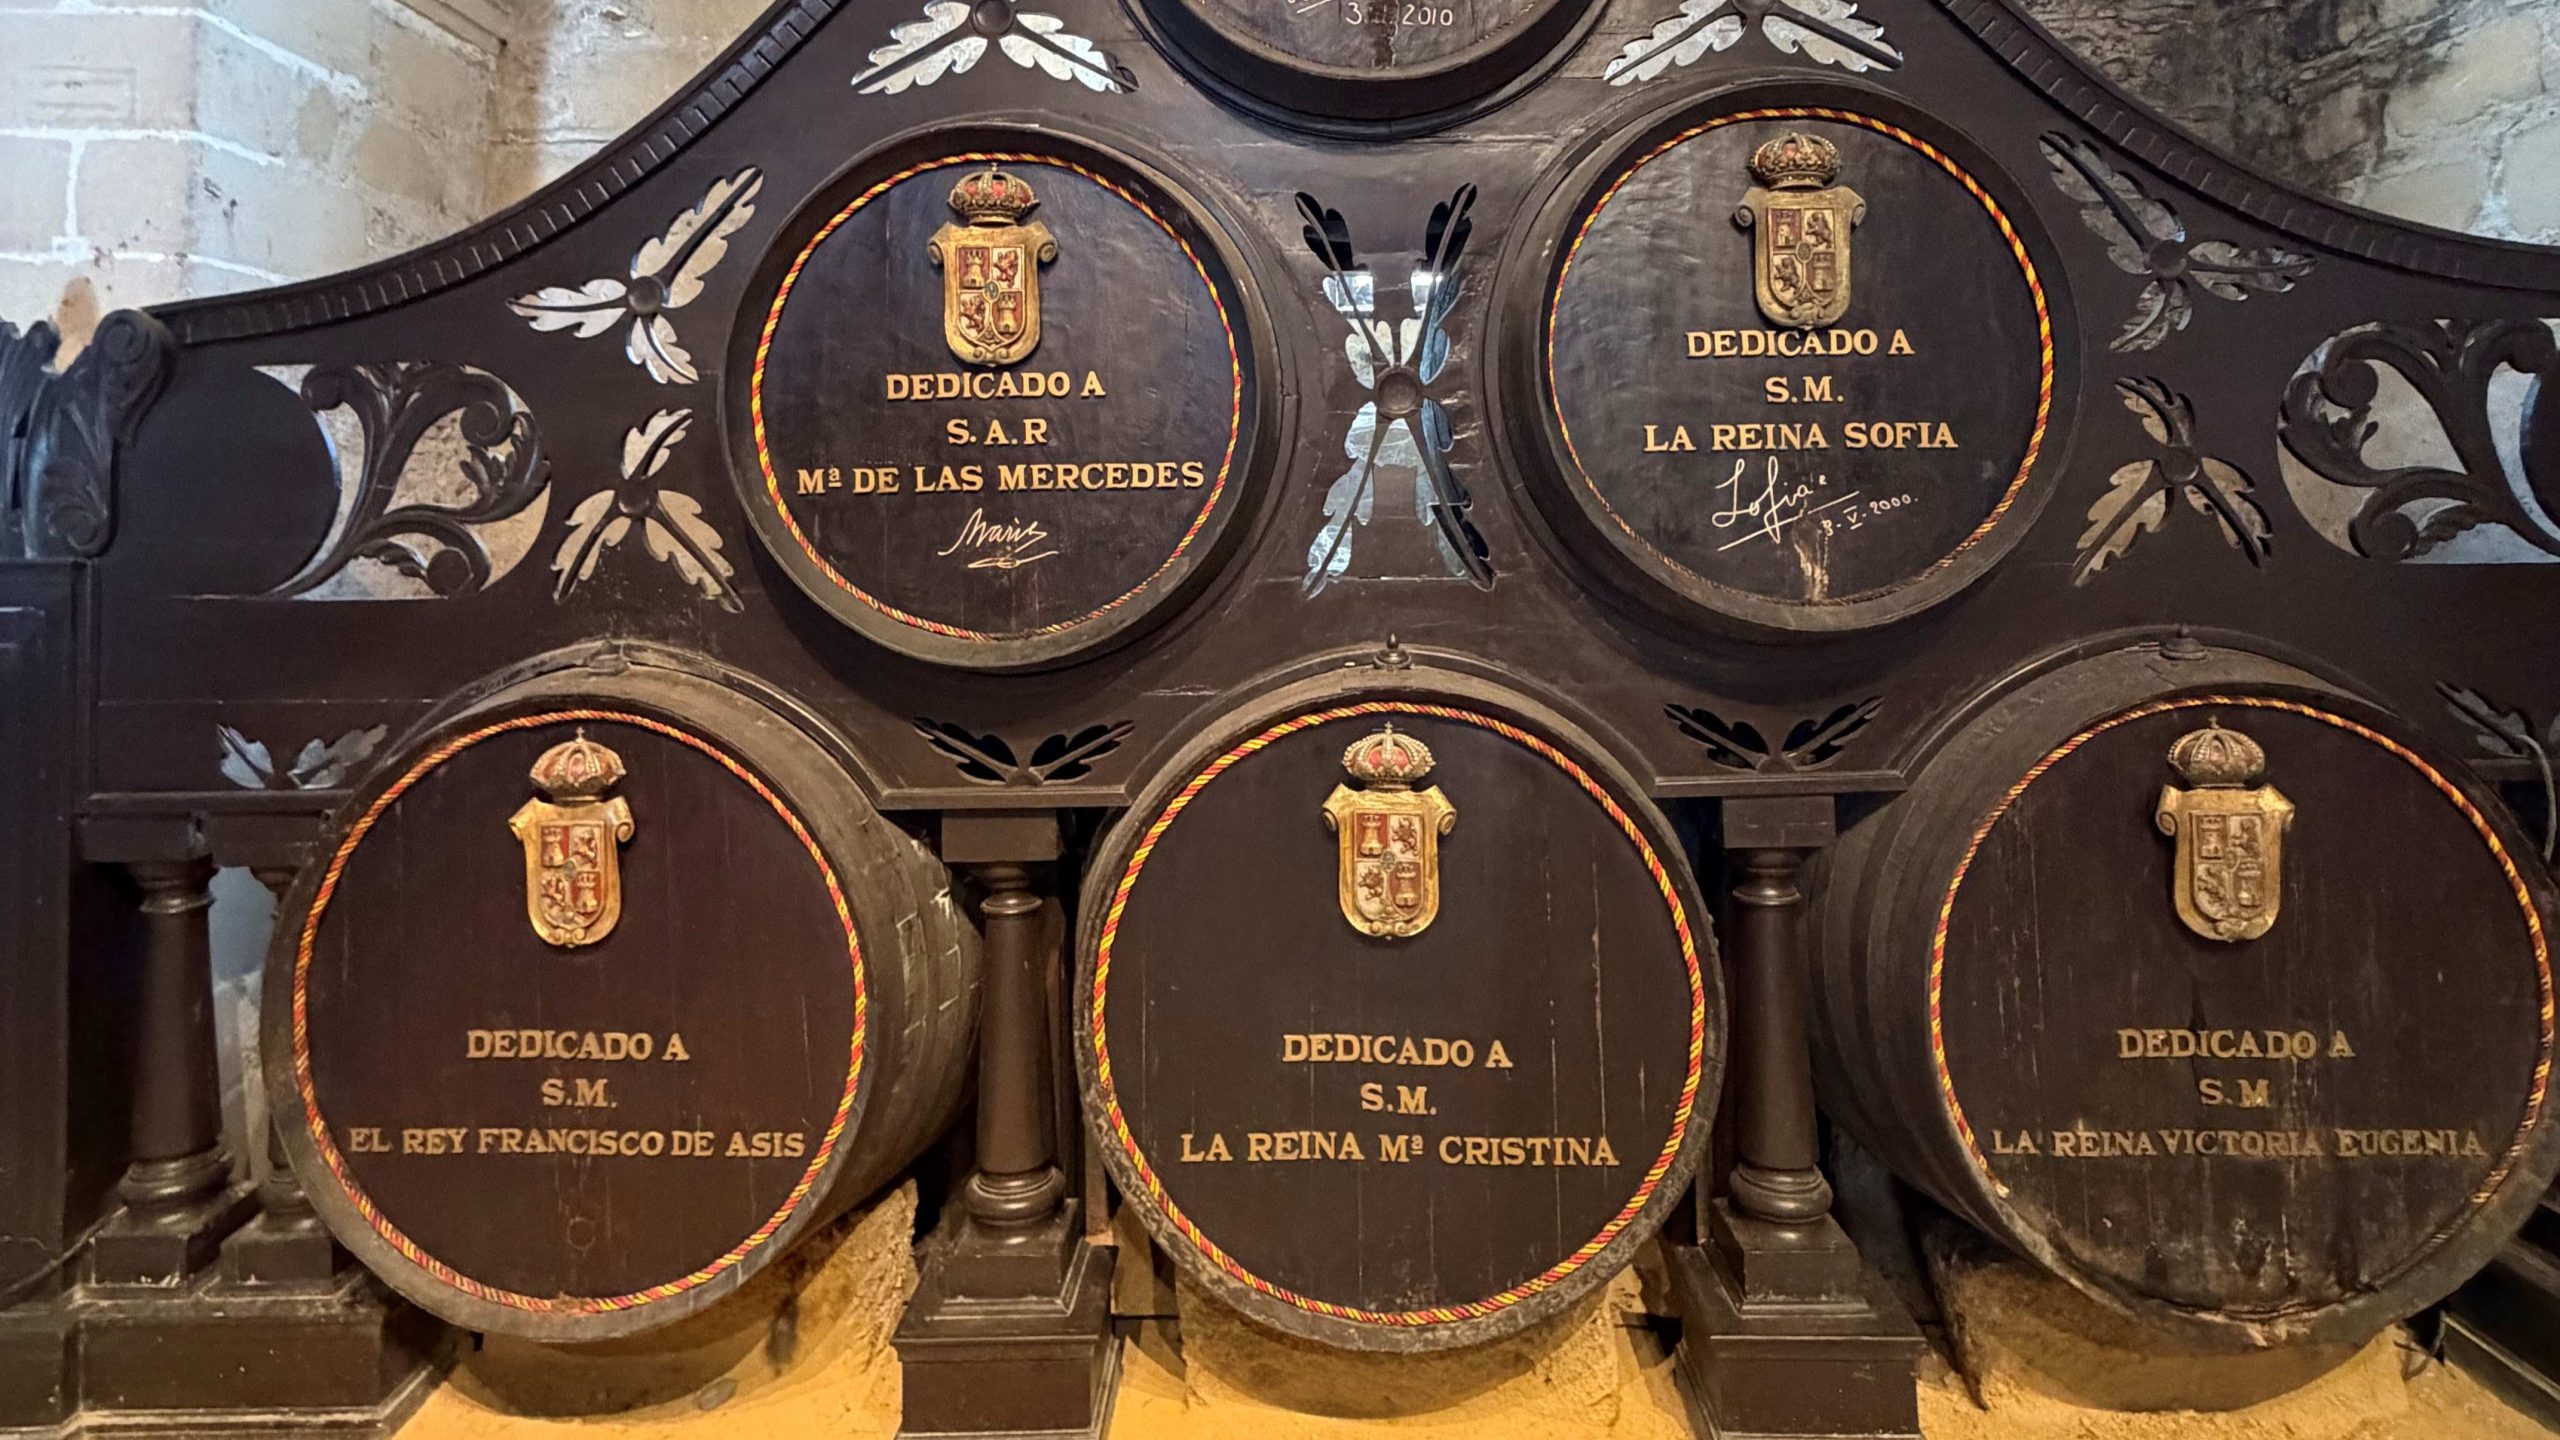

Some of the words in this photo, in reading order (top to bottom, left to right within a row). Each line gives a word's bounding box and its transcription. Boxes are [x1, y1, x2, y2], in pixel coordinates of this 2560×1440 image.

[1403, 4, 1454, 26] 2010
[1686, 330, 1878, 357] DEDICADO
[1888, 329, 1915, 355] A
[887, 372, 1071, 400] DEDICADO
[1081, 371, 1106, 398] A
[1765, 377, 1844, 403] S.M.
[1644, 425, 1696, 452] LA
[1711, 424, 1826, 451] REINA
[1845, 422, 1958, 450] SOFIA
[853, 467, 900, 493] DE
[915, 465, 983, 492] LAS
[998, 461, 1204, 491] MERCEDES
[467, 1030, 652, 1061] DEDICADO
[662, 1034, 689, 1062] A
[1282, 1034, 1474, 1068] DEDICADO
[1486, 1040, 1512, 1069] A
[2118, 1028, 2316, 1059] DEDICADO
[2329, 1030, 2354, 1058] A
[542, 1079, 616, 1108] S.M.
[1362, 1083, 1437, 1116] S.M.
[350, 1128, 391, 1153] EL
[403, 1128, 467, 1155] REY
[477, 1129, 664, 1156] FRANCISCO
[671, 1131, 714, 1157] DE
[724, 1131, 805, 1158] ASIS
[1181, 1133, 1232, 1162] LA
[1248, 1132, 1364, 1161] REINA
[1439, 1136, 1619, 1167] CRISTINA
[1994, 1131, 2038, 1155] LA
[2052, 1130, 2154, 1157] REINA
[2159, 1131, 2322, 1157] VICTORIA
[2336, 1130, 2488, 1158] EUGENIA
